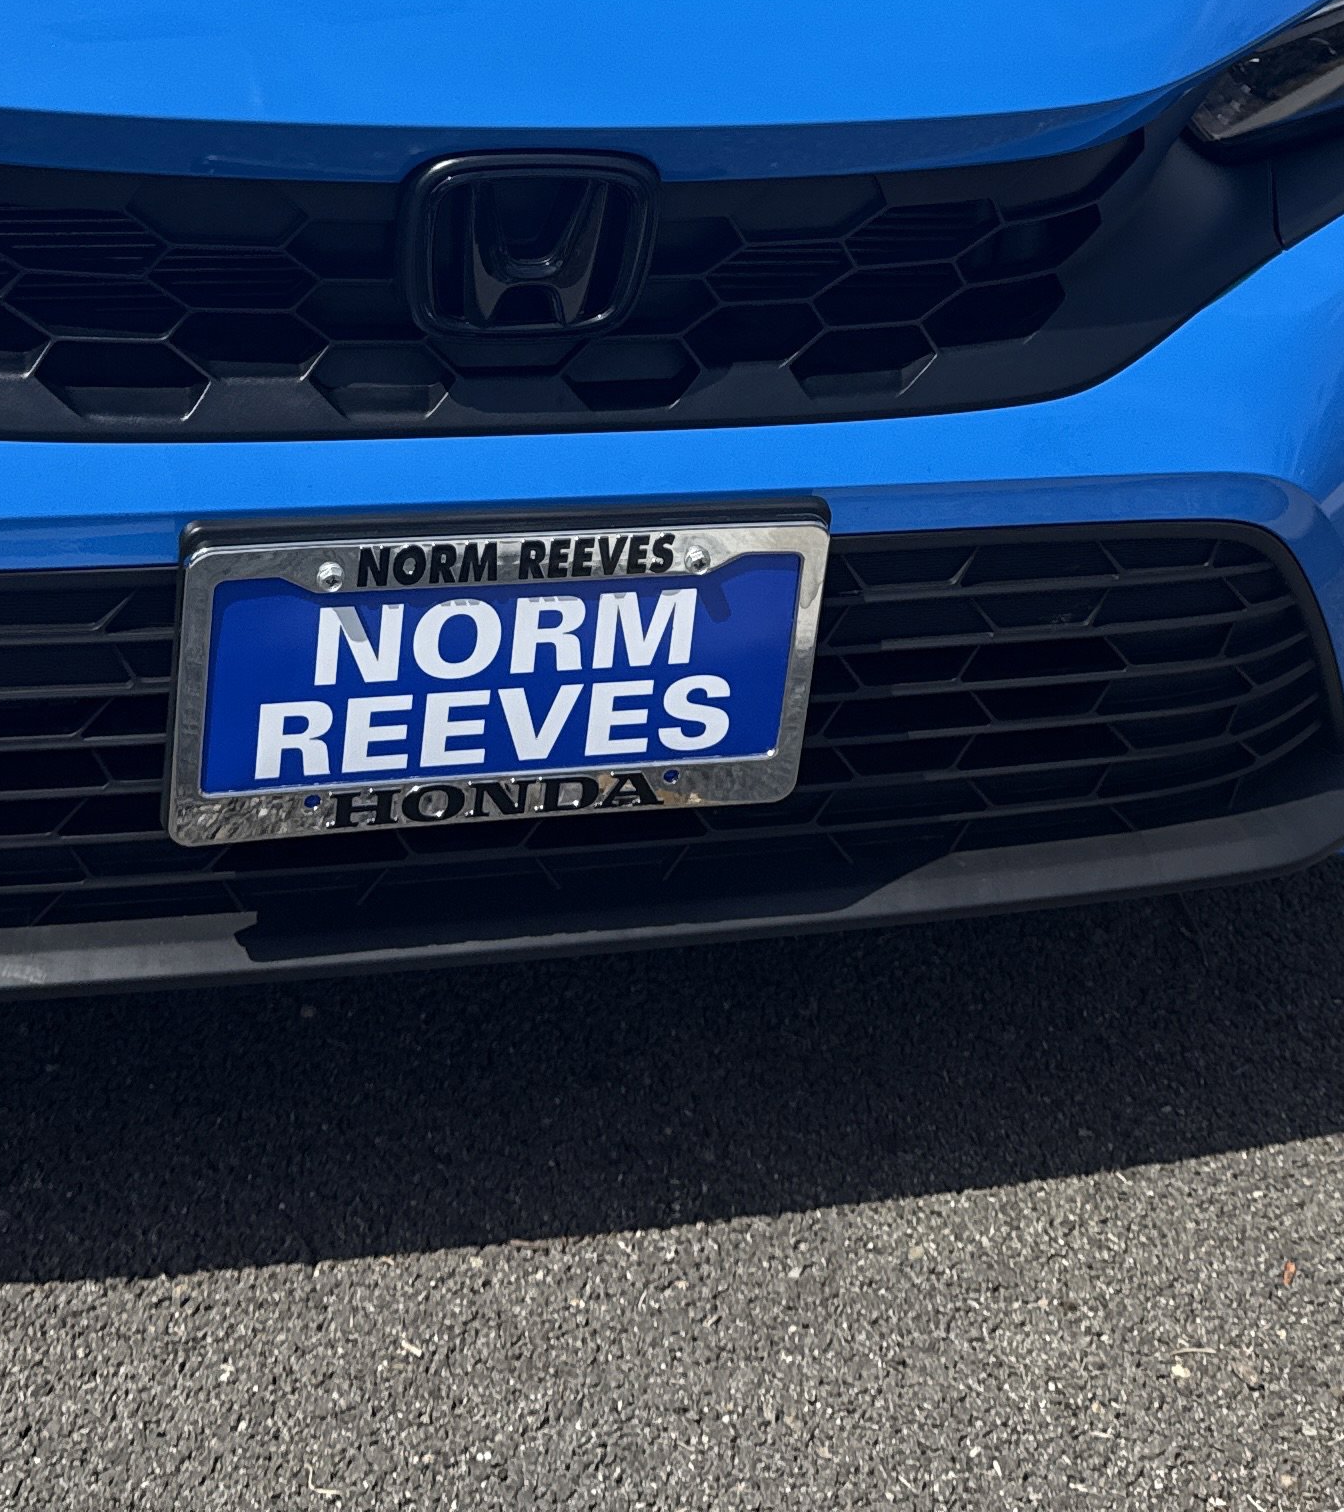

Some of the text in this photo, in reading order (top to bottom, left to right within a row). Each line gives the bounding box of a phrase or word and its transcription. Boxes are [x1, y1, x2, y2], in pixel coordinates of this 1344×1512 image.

[356, 532, 676, 587] NORM REEVES
[313, 587, 698, 687] NORM
[254, 674, 732, 780] REEVES
[329, 772, 665, 829] HONDA
